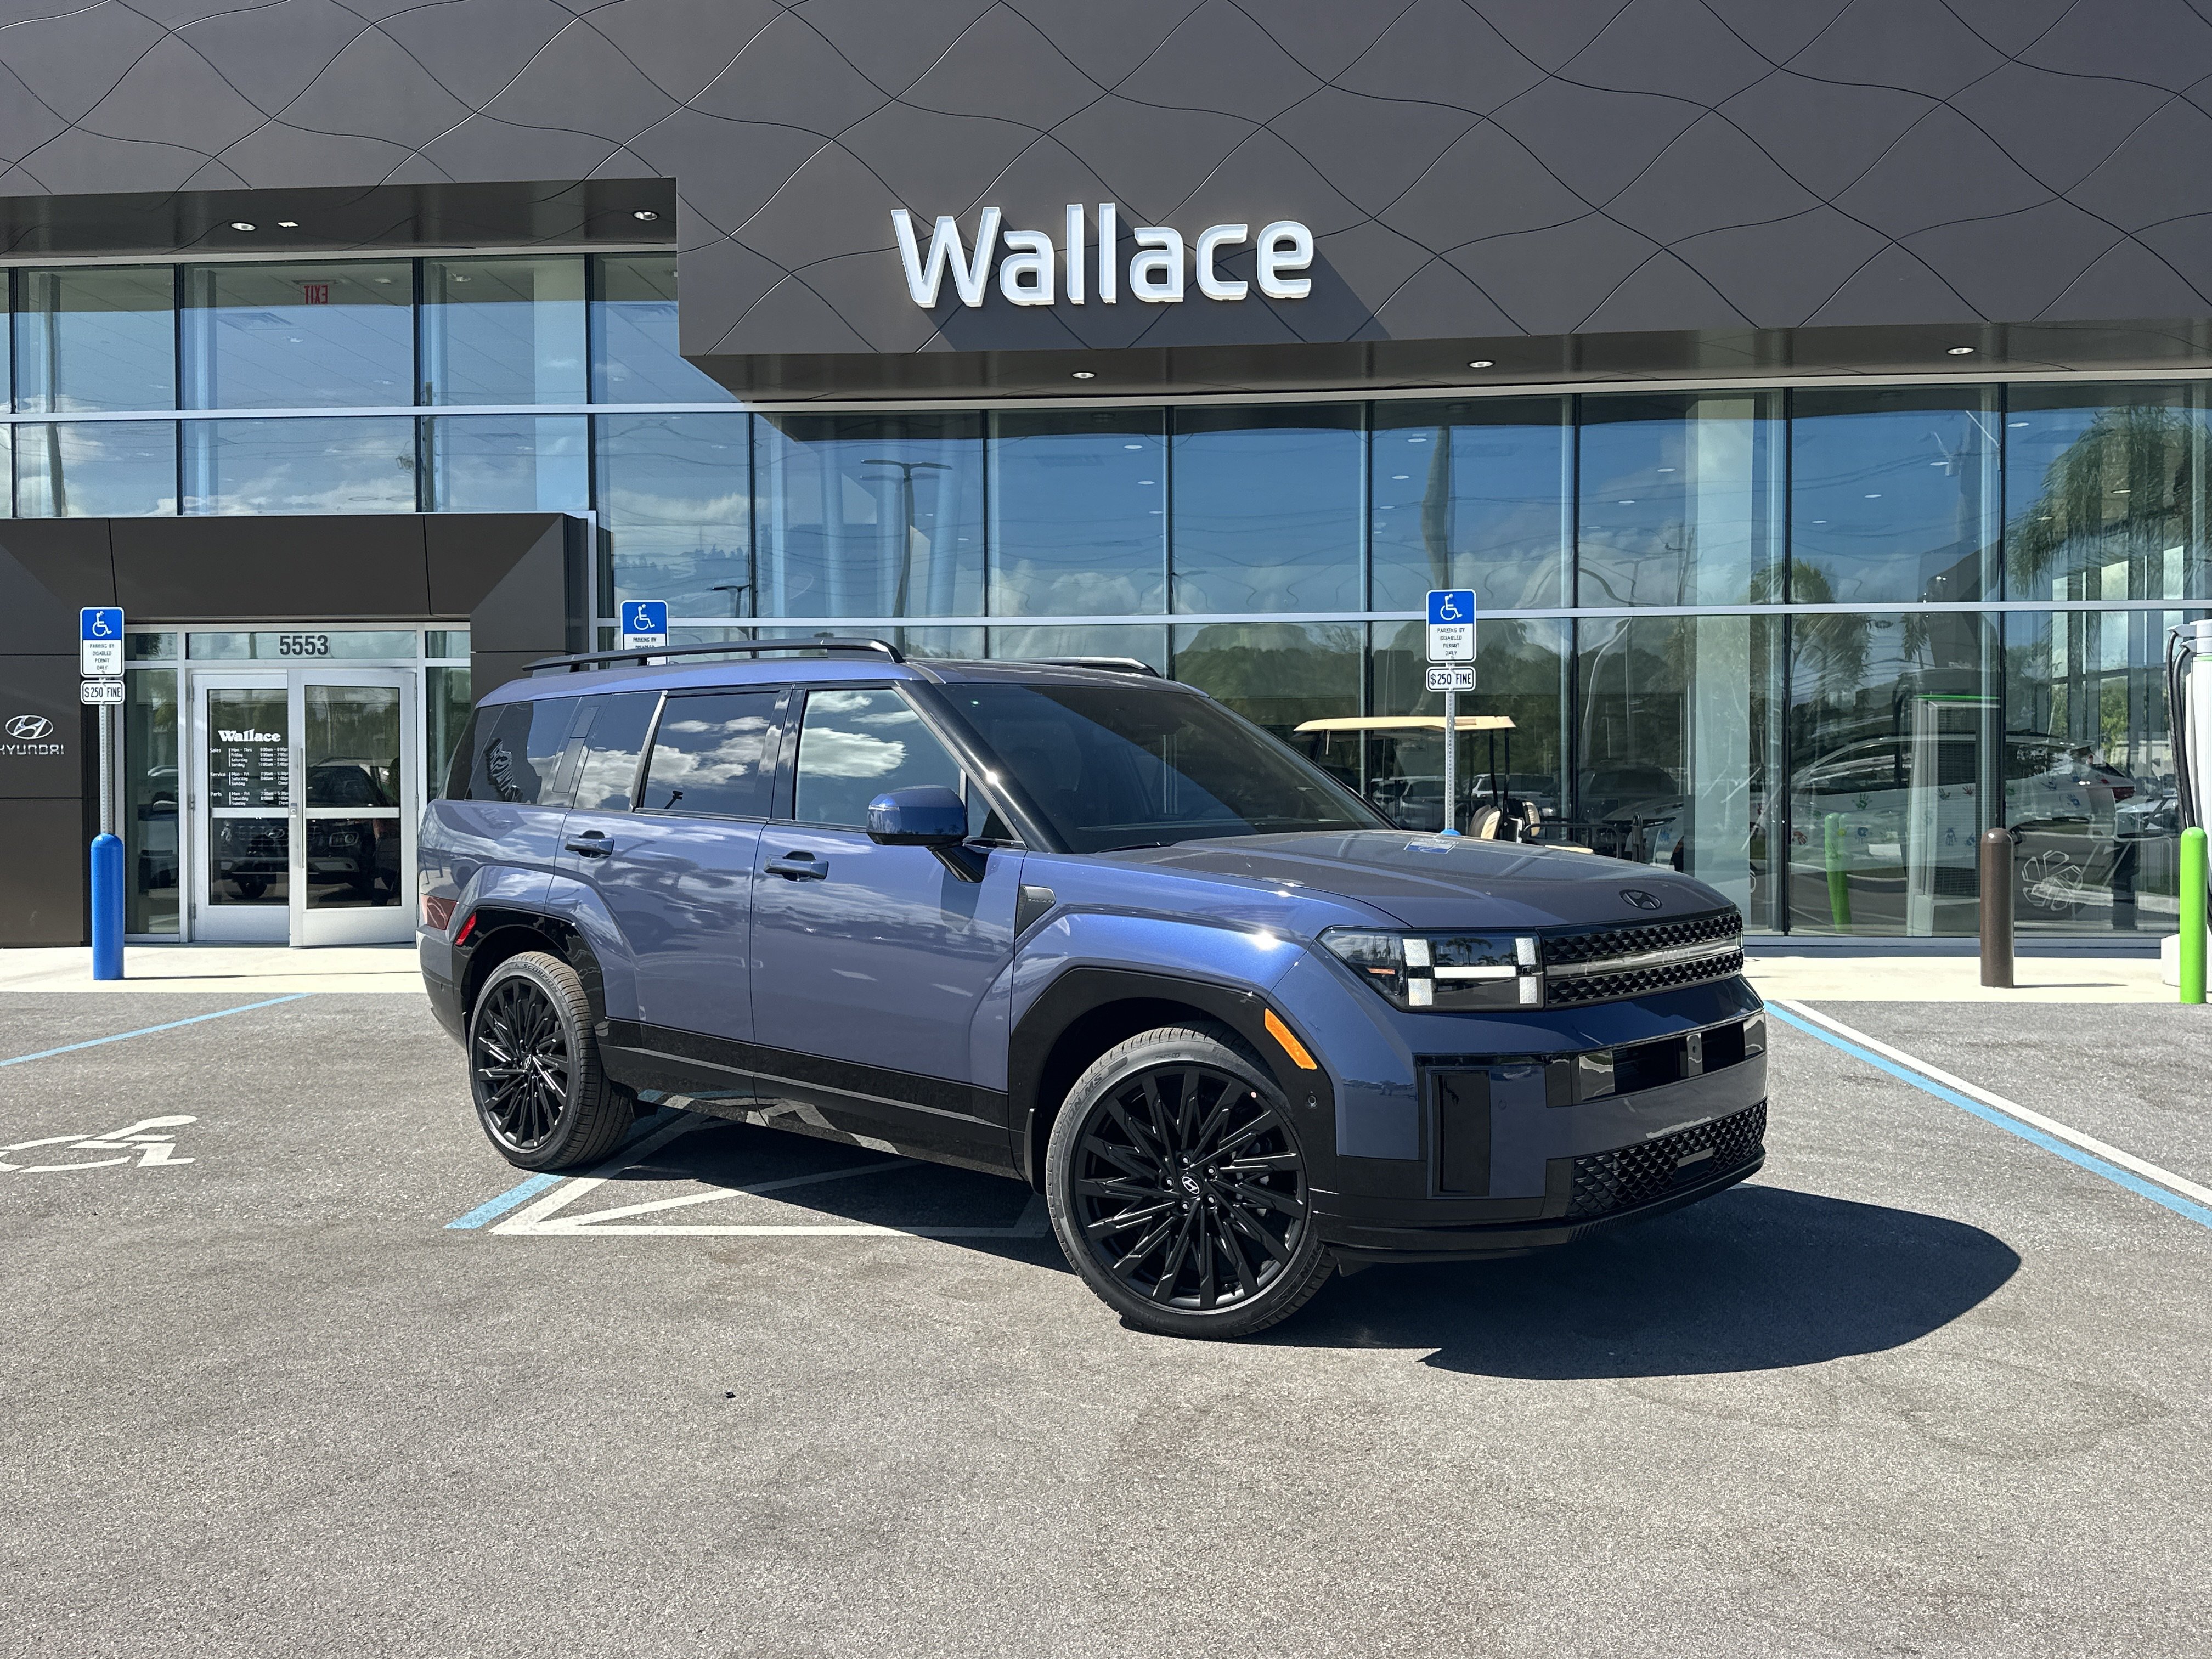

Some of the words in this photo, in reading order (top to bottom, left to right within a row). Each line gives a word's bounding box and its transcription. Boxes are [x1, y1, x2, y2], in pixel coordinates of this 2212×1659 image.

[891, 202, 1313, 308] Wallace
[279, 635, 328, 655] 5553
[1430, 673, 1452, 686] $250
[1456, 673, 1472, 684] FINE
[84, 687, 104, 698] $250
[107, 687, 121, 697] FINE
[218, 729, 281, 742] Wallace
[522, 963, 558, 993] SCORPION
[1085, 1073, 1102, 1096] MS
